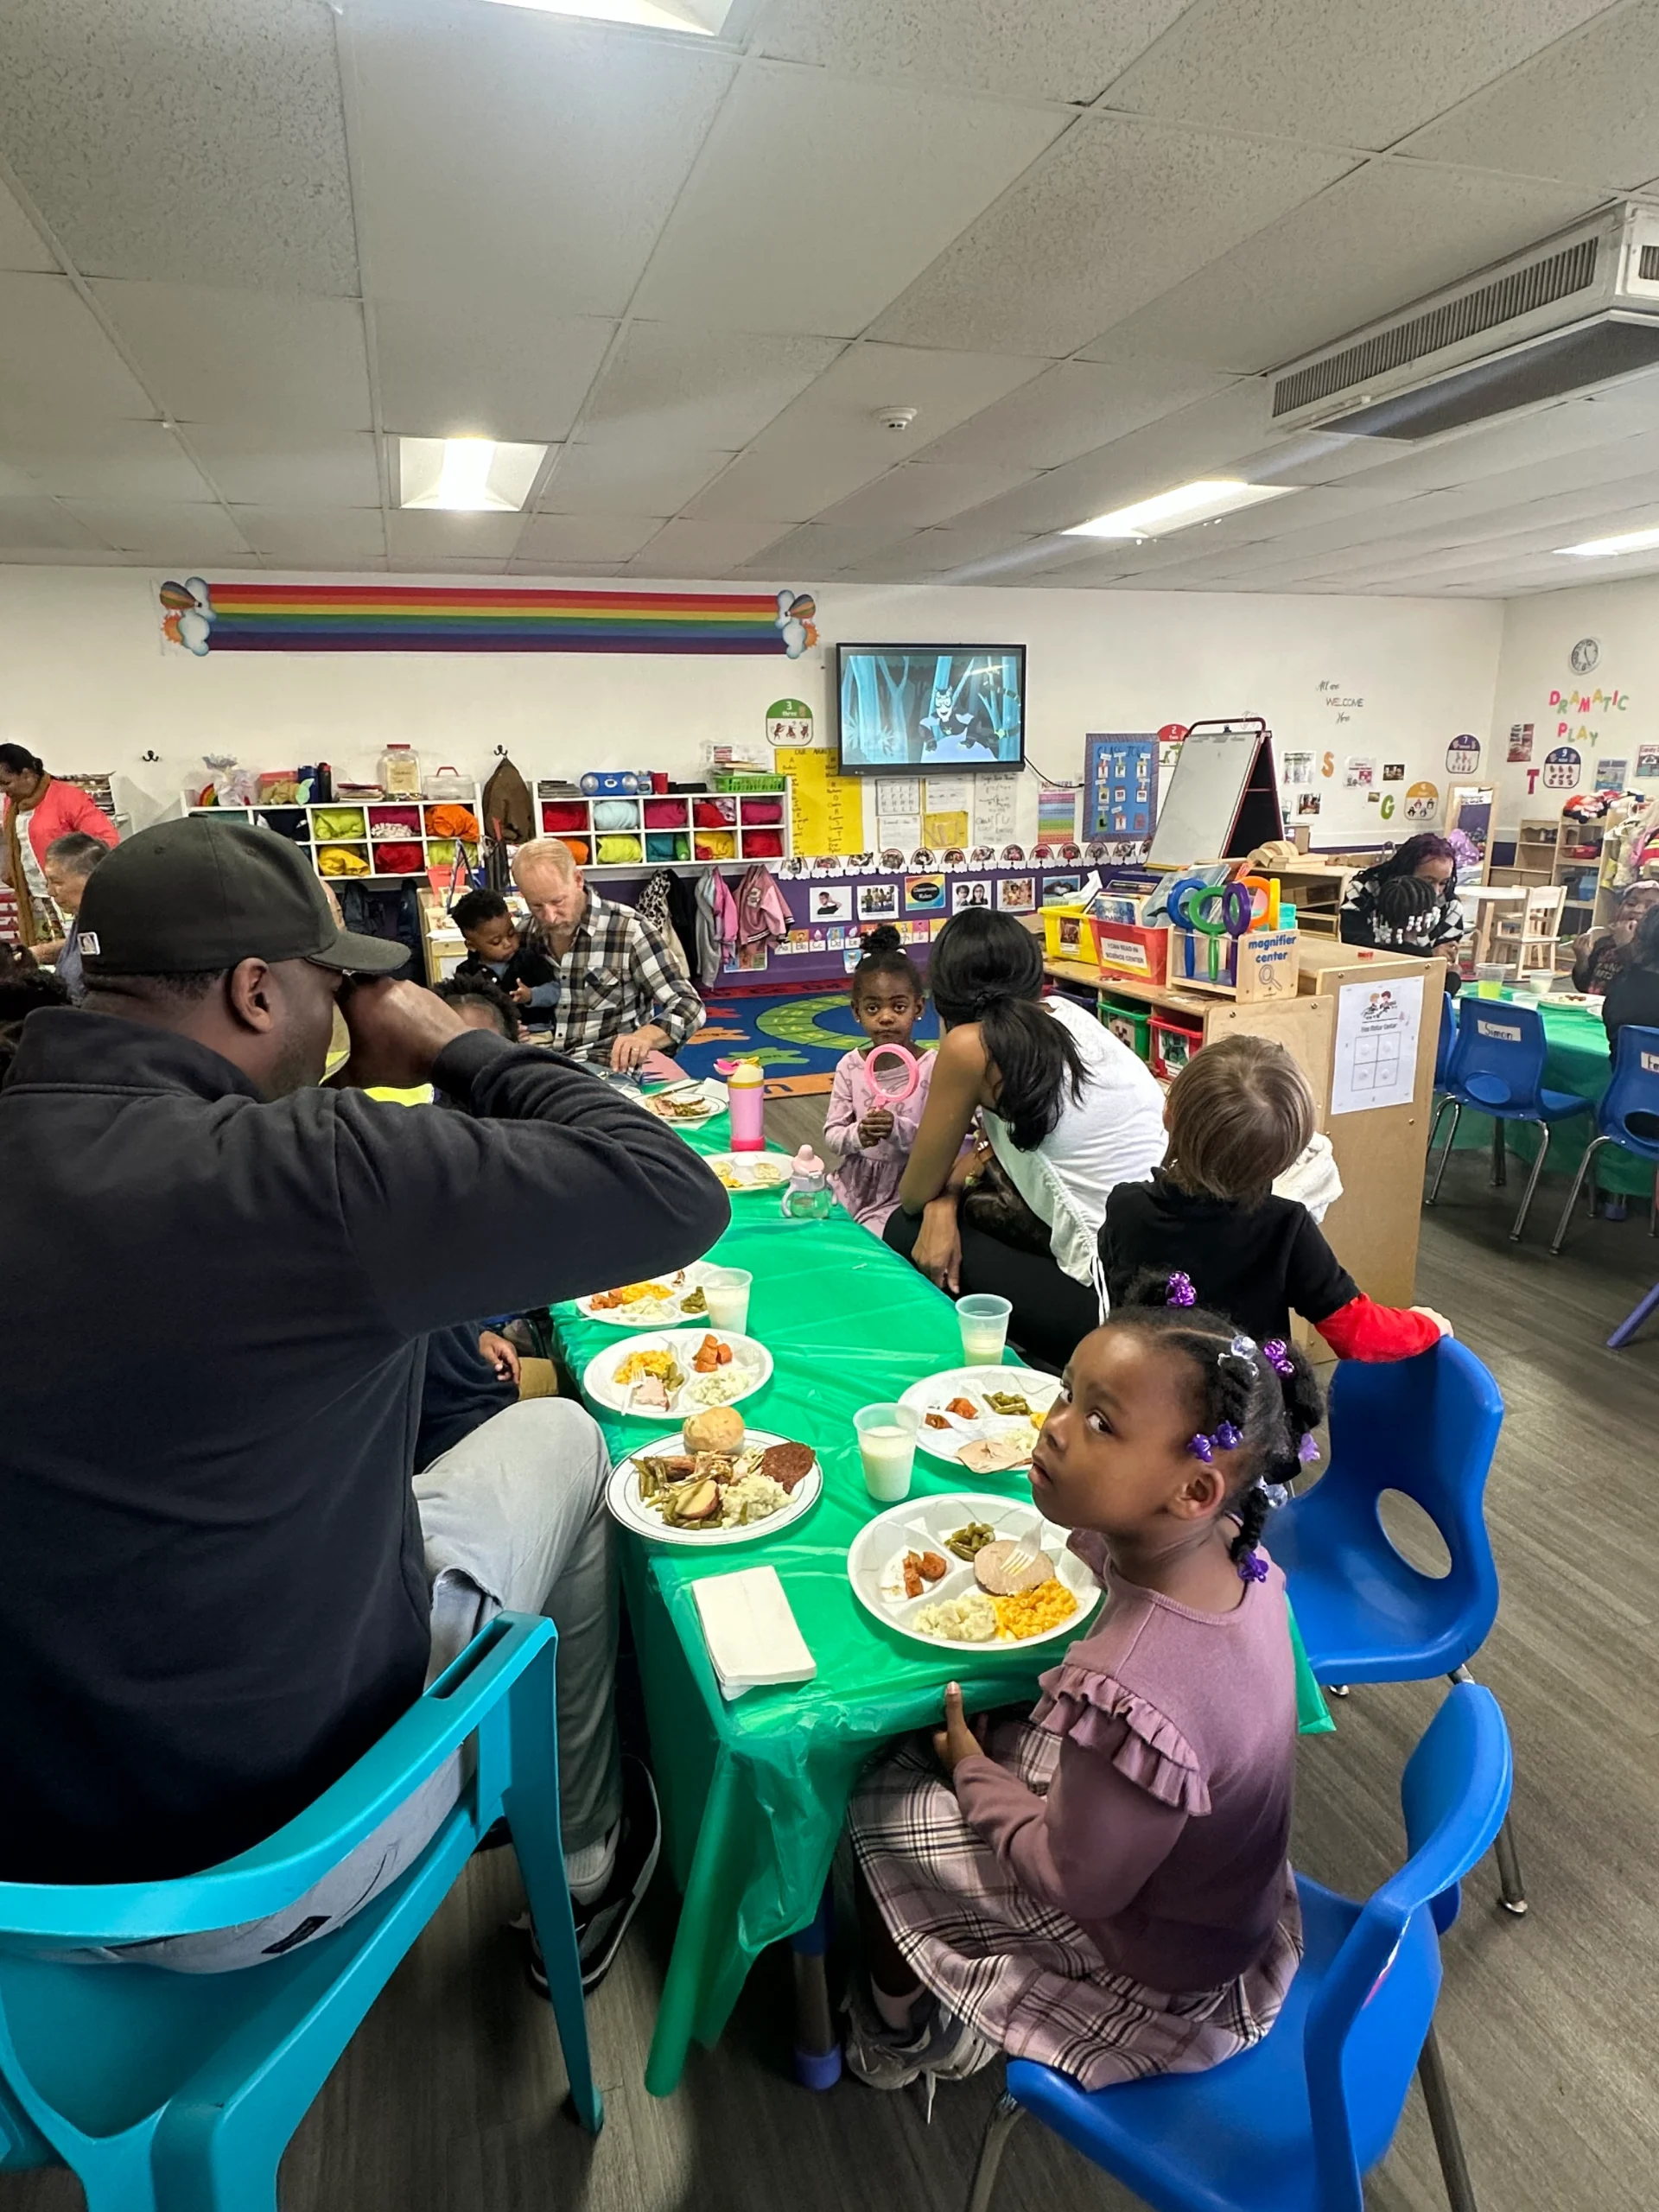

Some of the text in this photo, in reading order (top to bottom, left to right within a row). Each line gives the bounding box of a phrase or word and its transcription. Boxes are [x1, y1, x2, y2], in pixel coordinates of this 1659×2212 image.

[785, 701, 792, 709] 3
[1325, 697, 1364, 707] WELCOME
[1548, 689, 1629, 714] DRAMATIC
[1462, 735, 1468, 744] 7
[1557, 722, 1599, 747] PLAY
[1561, 748, 1567, 757] 9
[1320, 751, 1335, 778] S
[1526, 768, 1540, 794] T
[1380, 794, 1395, 820] G
[1248, 934, 1297, 950] magnifier
[1105, 951, 1144, 963] SCIENCE CENTER
[1255, 951, 1287, 963] center
[1484, 1023, 1512, 1040] Simon
